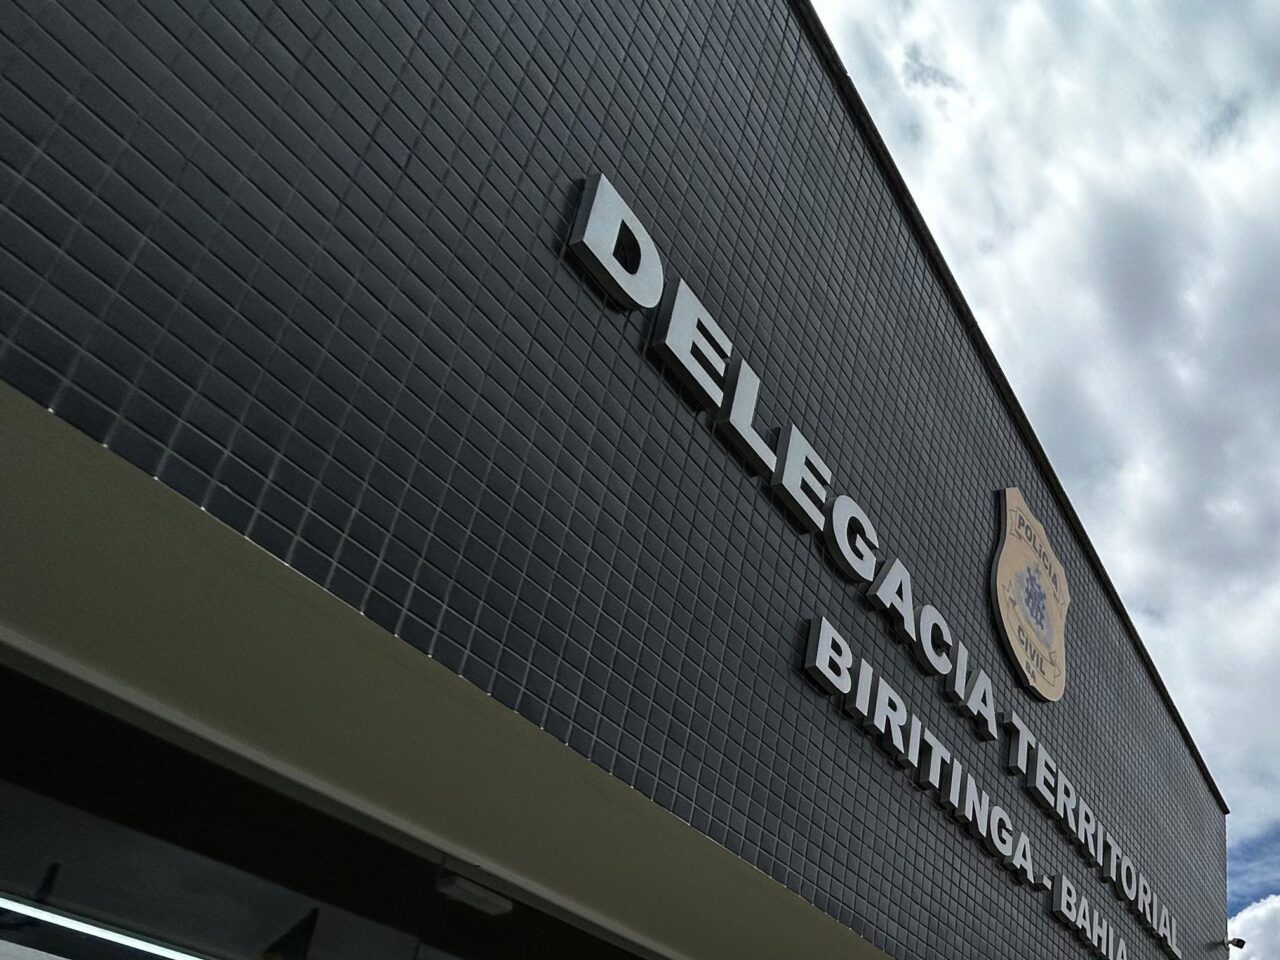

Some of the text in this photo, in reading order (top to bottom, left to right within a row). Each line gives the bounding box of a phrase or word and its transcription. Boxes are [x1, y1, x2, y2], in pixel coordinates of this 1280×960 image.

[580, 172, 1182, 960] DELEGACIA TERRITORIAL
[1017, 624, 1046, 676] CIVIL
[1025, 660, 1037, 683] BA
[812, 615, 1035, 884] BIRITINGA
